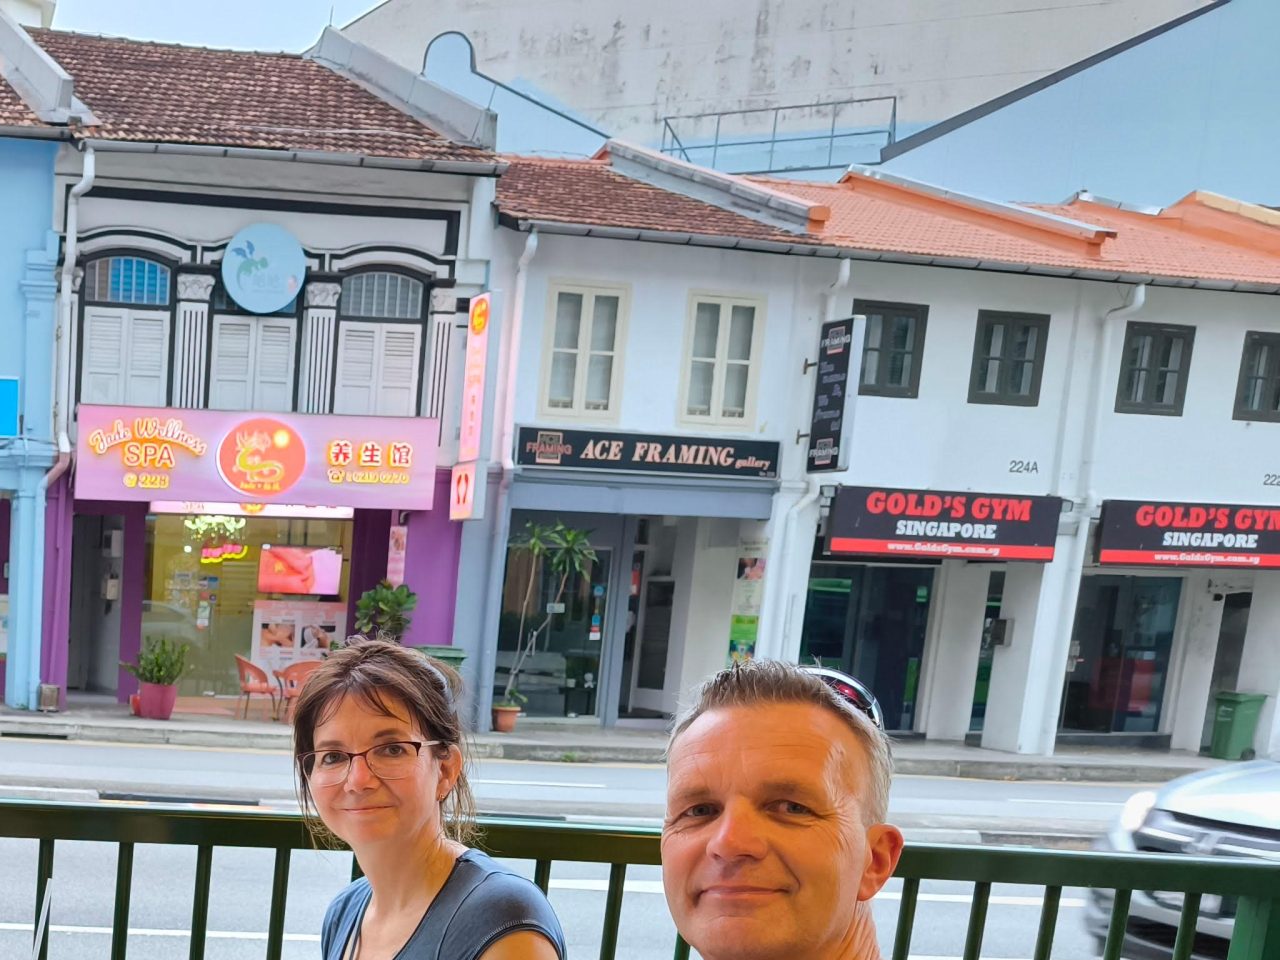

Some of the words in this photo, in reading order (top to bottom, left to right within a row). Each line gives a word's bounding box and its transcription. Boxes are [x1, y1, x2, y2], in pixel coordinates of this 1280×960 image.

[90, 420, 132, 455] Jade
[135, 418, 208, 455] Wellness
[526, 442, 572, 455] FRAMING
[124, 443, 175, 467] SPA
[330, 440, 412, 468] 养生馆
[580, 438, 624, 462] ACE
[632, 441, 735, 466] FRAMING
[735, 456, 771, 470] gallery
[1009, 460, 1039, 474] 224A
[866, 491, 967, 519] GOLD'S
[971, 497, 1033, 521] GYM
[1136, 505, 1230, 529] GOLD'S
[895, 519, 997, 539] SINGAPORE
[1162, 531, 1259, 548] SINGAPORE
